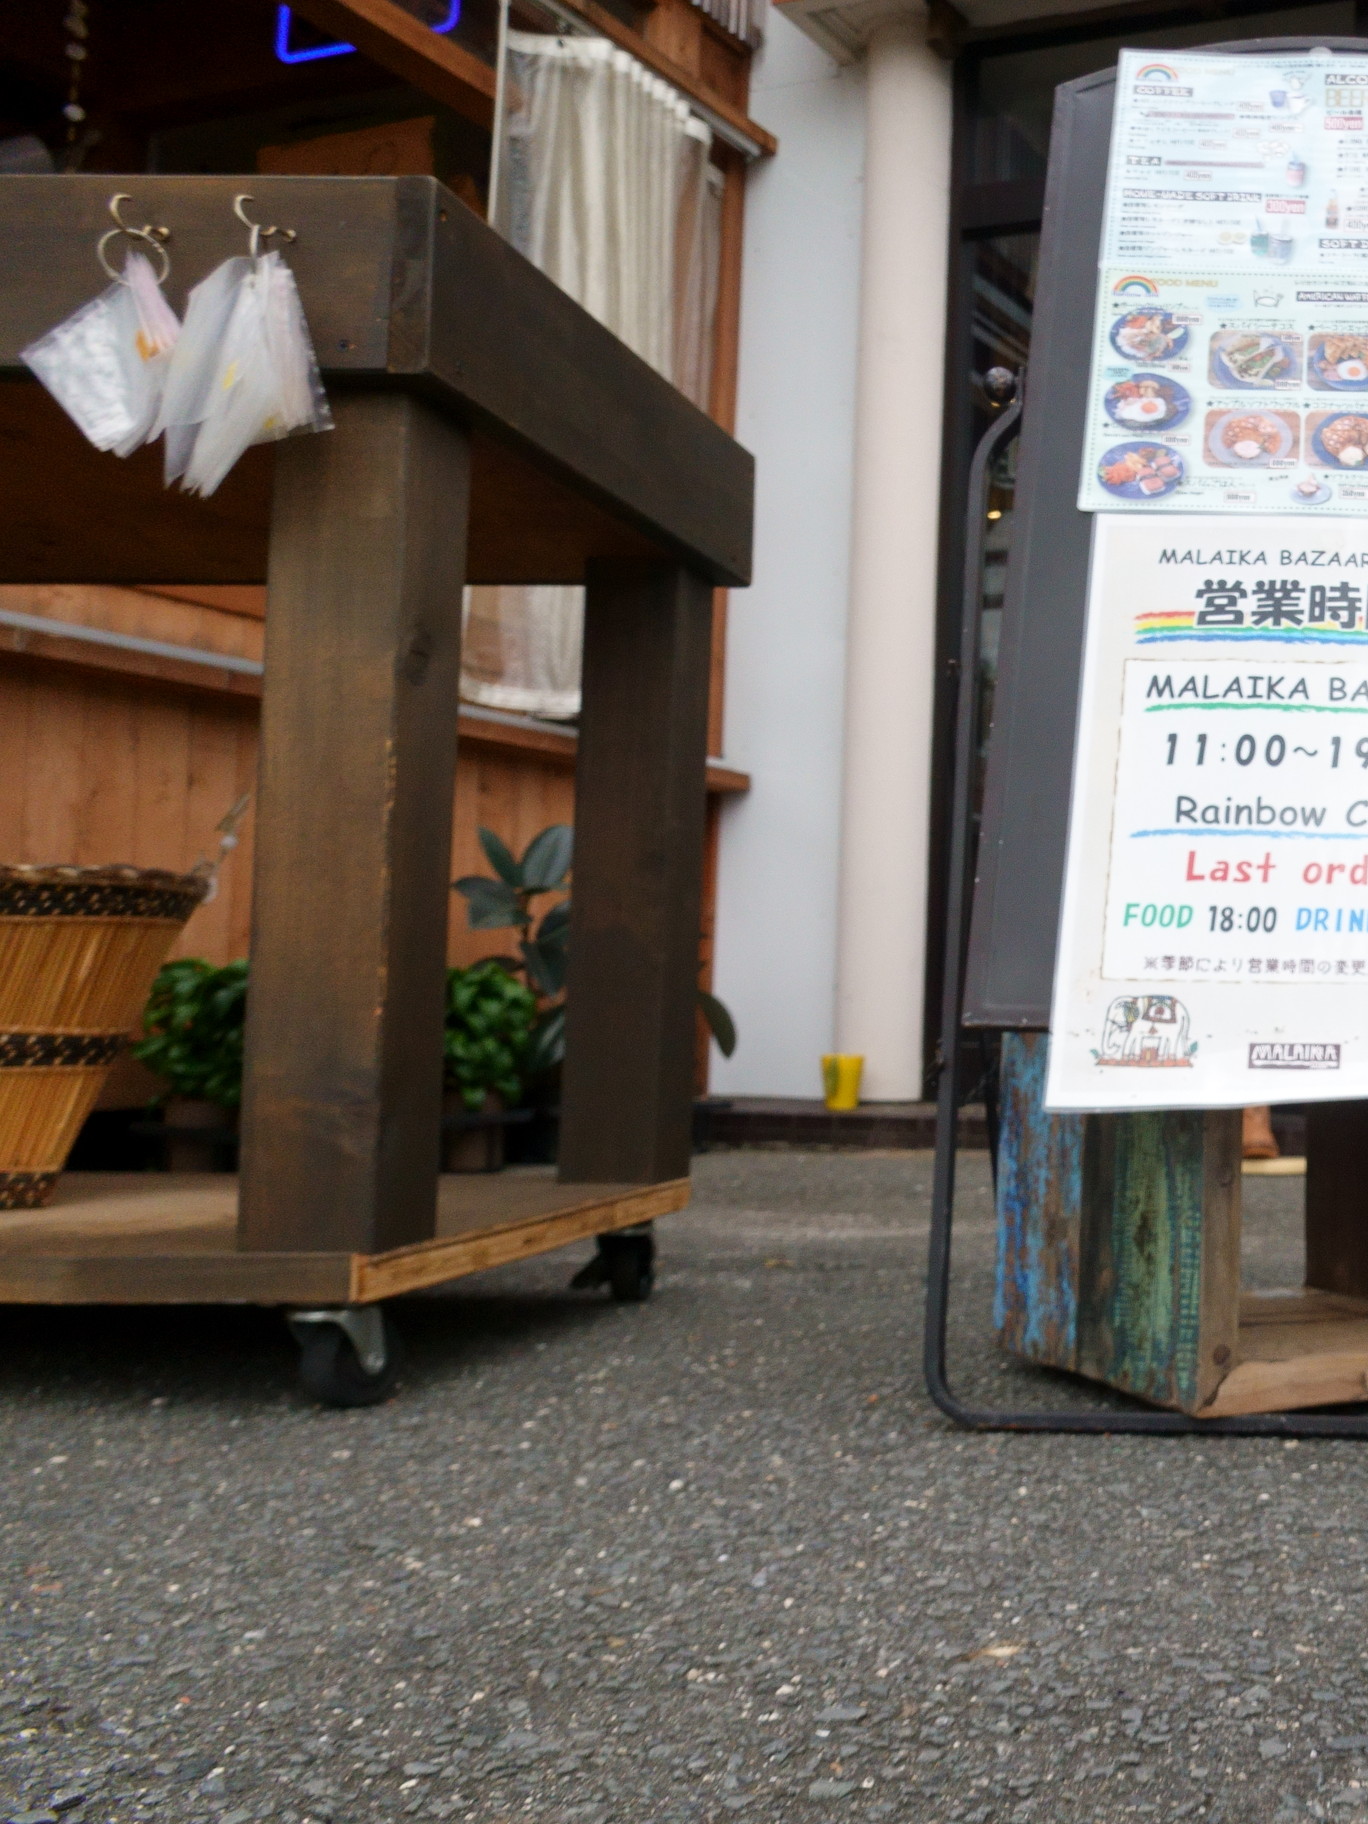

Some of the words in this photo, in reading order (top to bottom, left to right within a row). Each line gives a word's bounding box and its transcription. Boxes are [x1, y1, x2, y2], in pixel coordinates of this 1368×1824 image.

[1135, 86, 1191, 97] COFFEE
[1129, 157, 1160, 166] TEA
[1196, 191, 1225, 201] SOFT
[1321, 239, 1359, 250] SOFT
[1158, 548, 1268, 567] MALAIKA
[1146, 675, 1310, 700] MALAIKA
[1175, 795, 1327, 827] Rainbow
[1185, 850, 1276, 883] Last
[1123, 903, 1194, 928] FOOD
[1208, 905, 1278, 934] 18:00
[1251, 1044, 1337, 1061] MALAIKA
